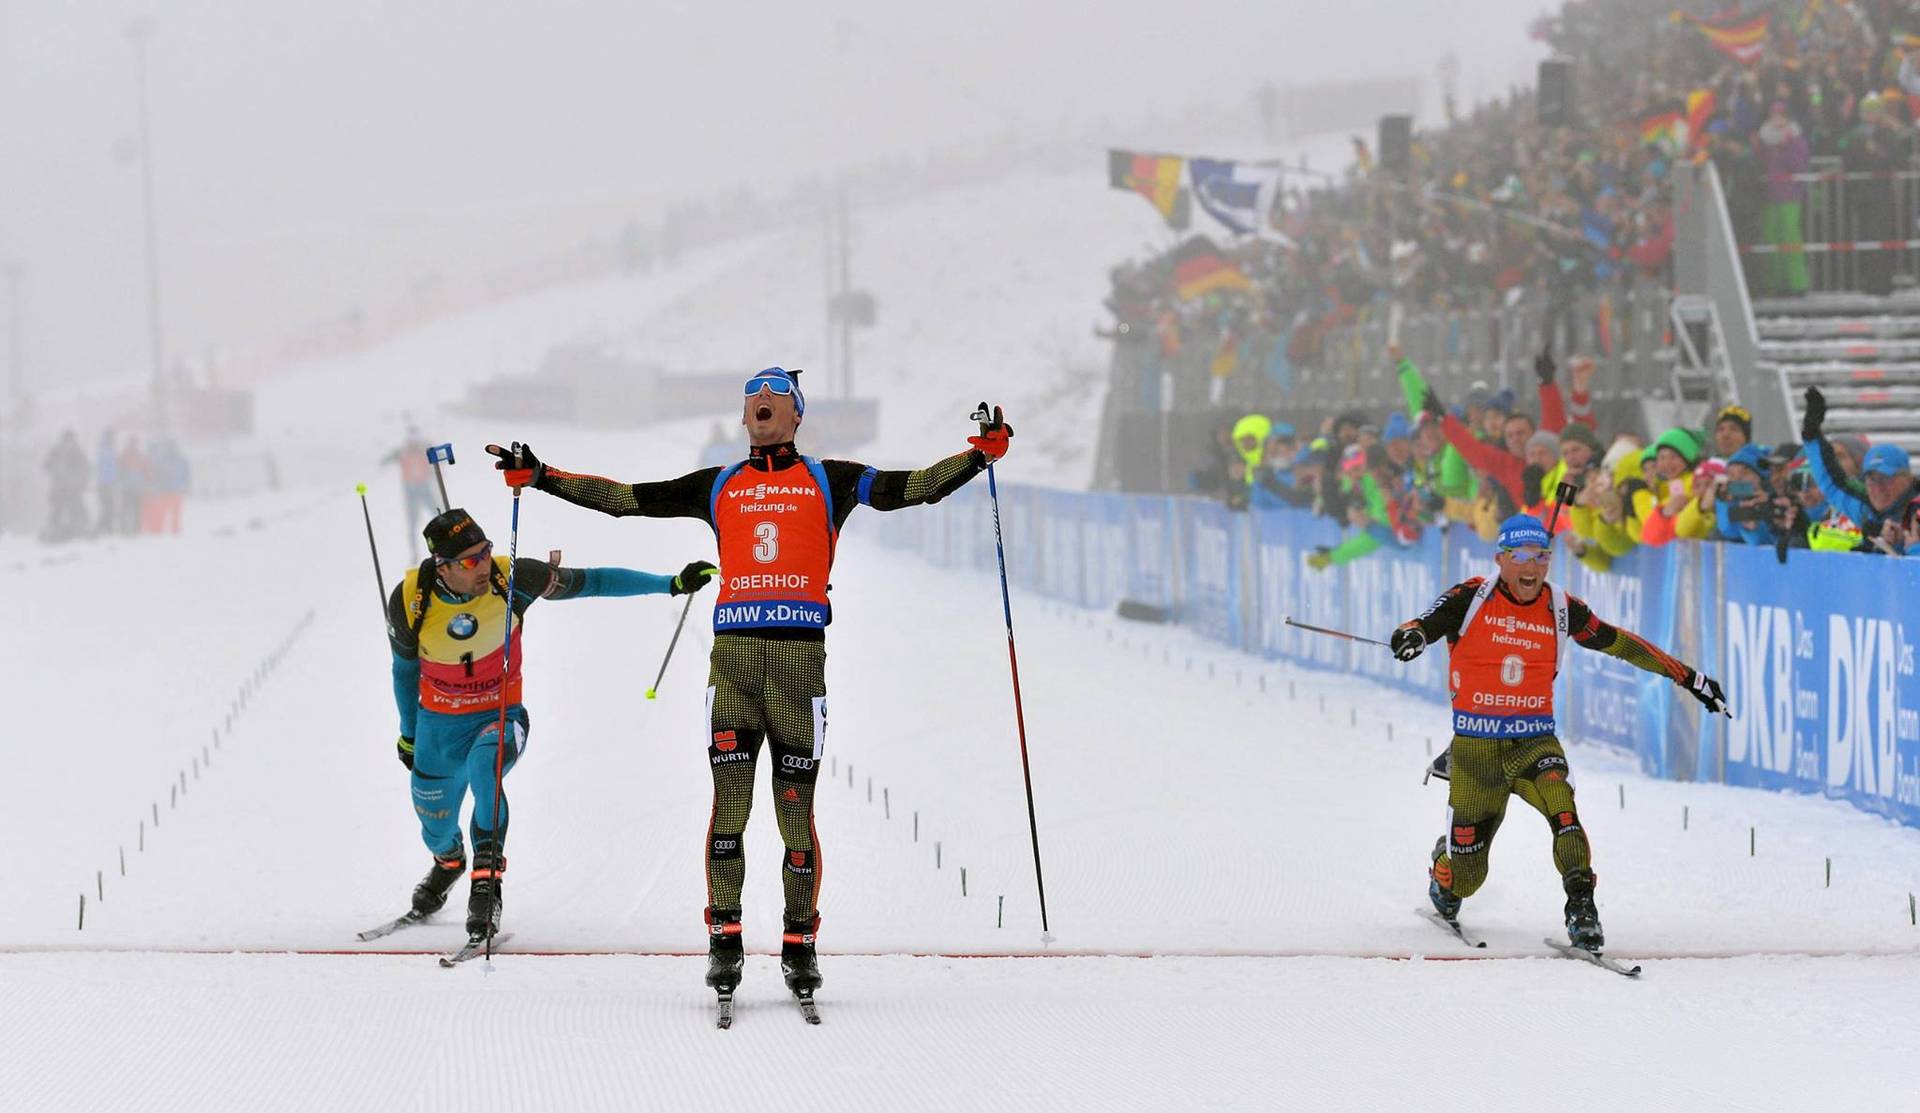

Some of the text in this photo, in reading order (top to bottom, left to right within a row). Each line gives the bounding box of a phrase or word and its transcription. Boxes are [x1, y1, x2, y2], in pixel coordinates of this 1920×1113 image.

[728, 484, 816, 500] VIESSMANN
[740, 503, 798, 514] heizung.de
[753, 521, 779, 564] 3
[730, 574, 809, 590] OBERHOF
[717, 604, 822, 624] BMW xDrive
[1558, 607, 1567, 633] JOKA
[1484, 615, 1554, 636] VIESSMANN
[1492, 632, 1542, 650] heizung.de
[460, 651, 474, 677] 1
[1727, 601, 1793, 774] DKB
[1472, 692, 1547, 708] OBERHOF
[1827, 613, 1896, 798] DKB
[1456, 715, 1501, 733] BMW
